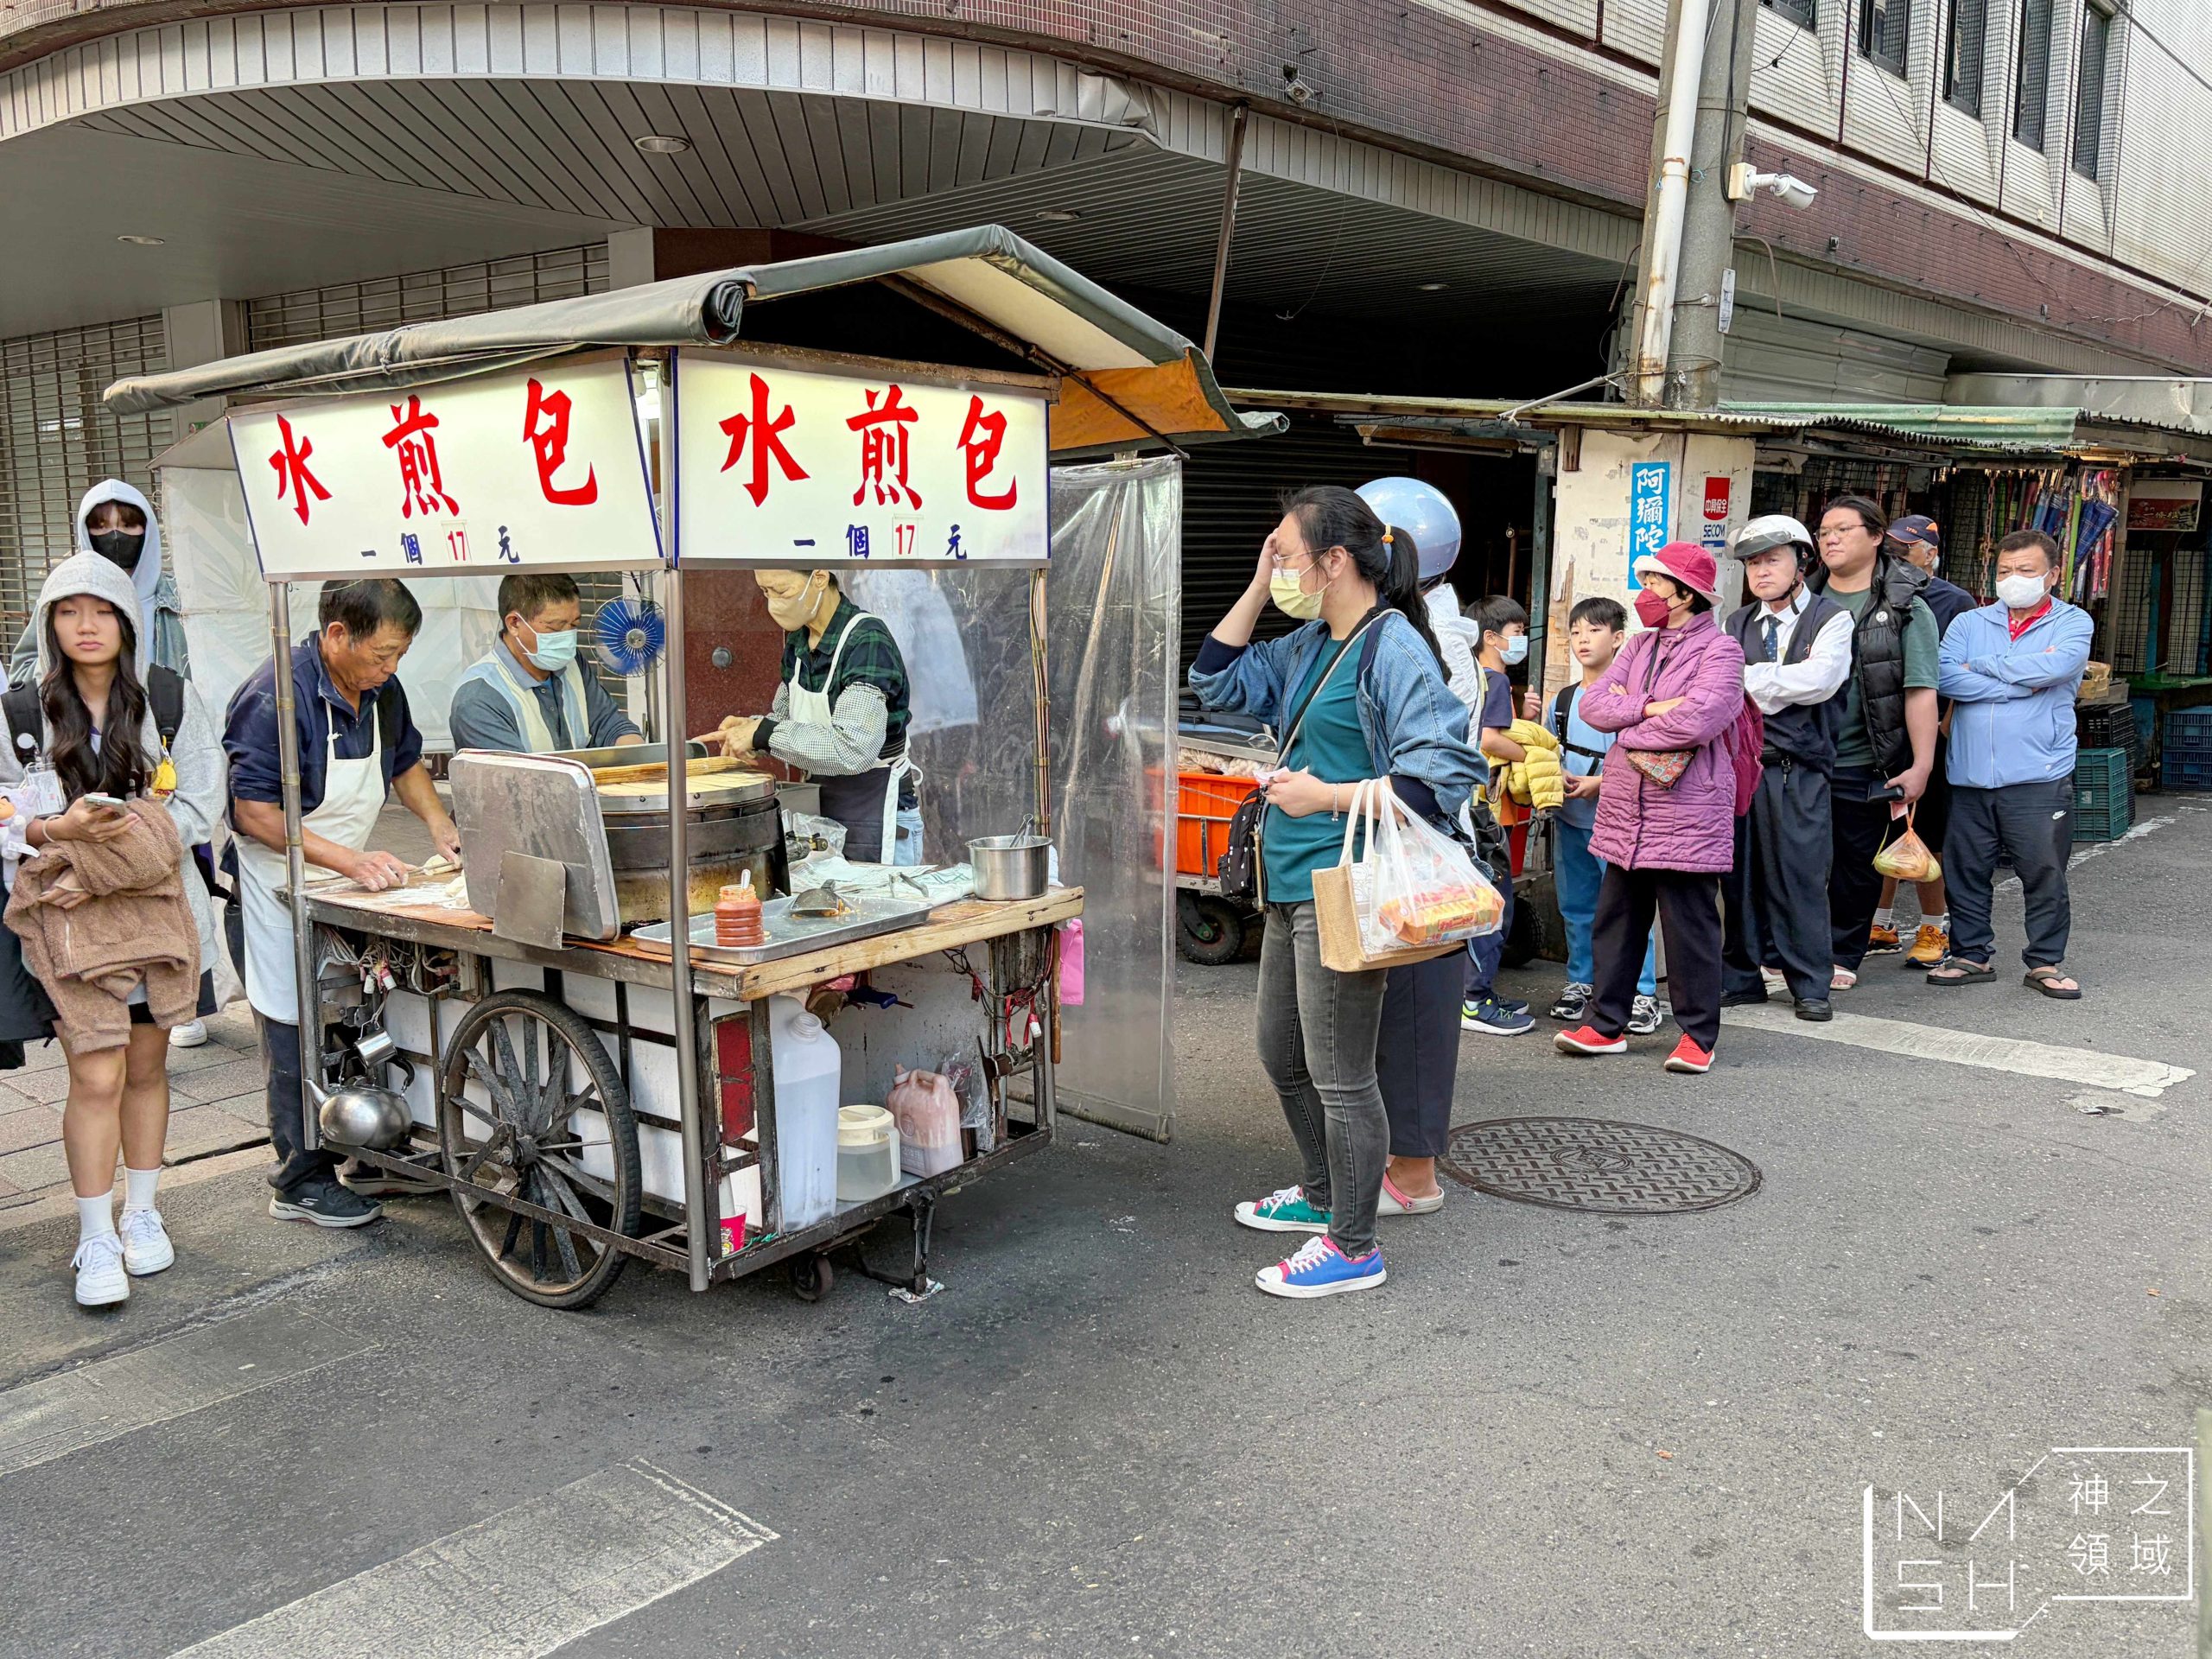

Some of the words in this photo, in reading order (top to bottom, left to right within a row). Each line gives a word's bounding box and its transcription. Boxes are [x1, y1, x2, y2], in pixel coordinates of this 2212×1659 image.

[269, 378, 598, 525] 水煎包
[719, 372, 1018, 511] 水煎包
[360, 524, 520, 565] 一個17元
[793, 524, 968, 560] 一個17元
[1635, 467, 1666, 558] 阿彌陀
[1703, 524, 1726, 537] SECOM
